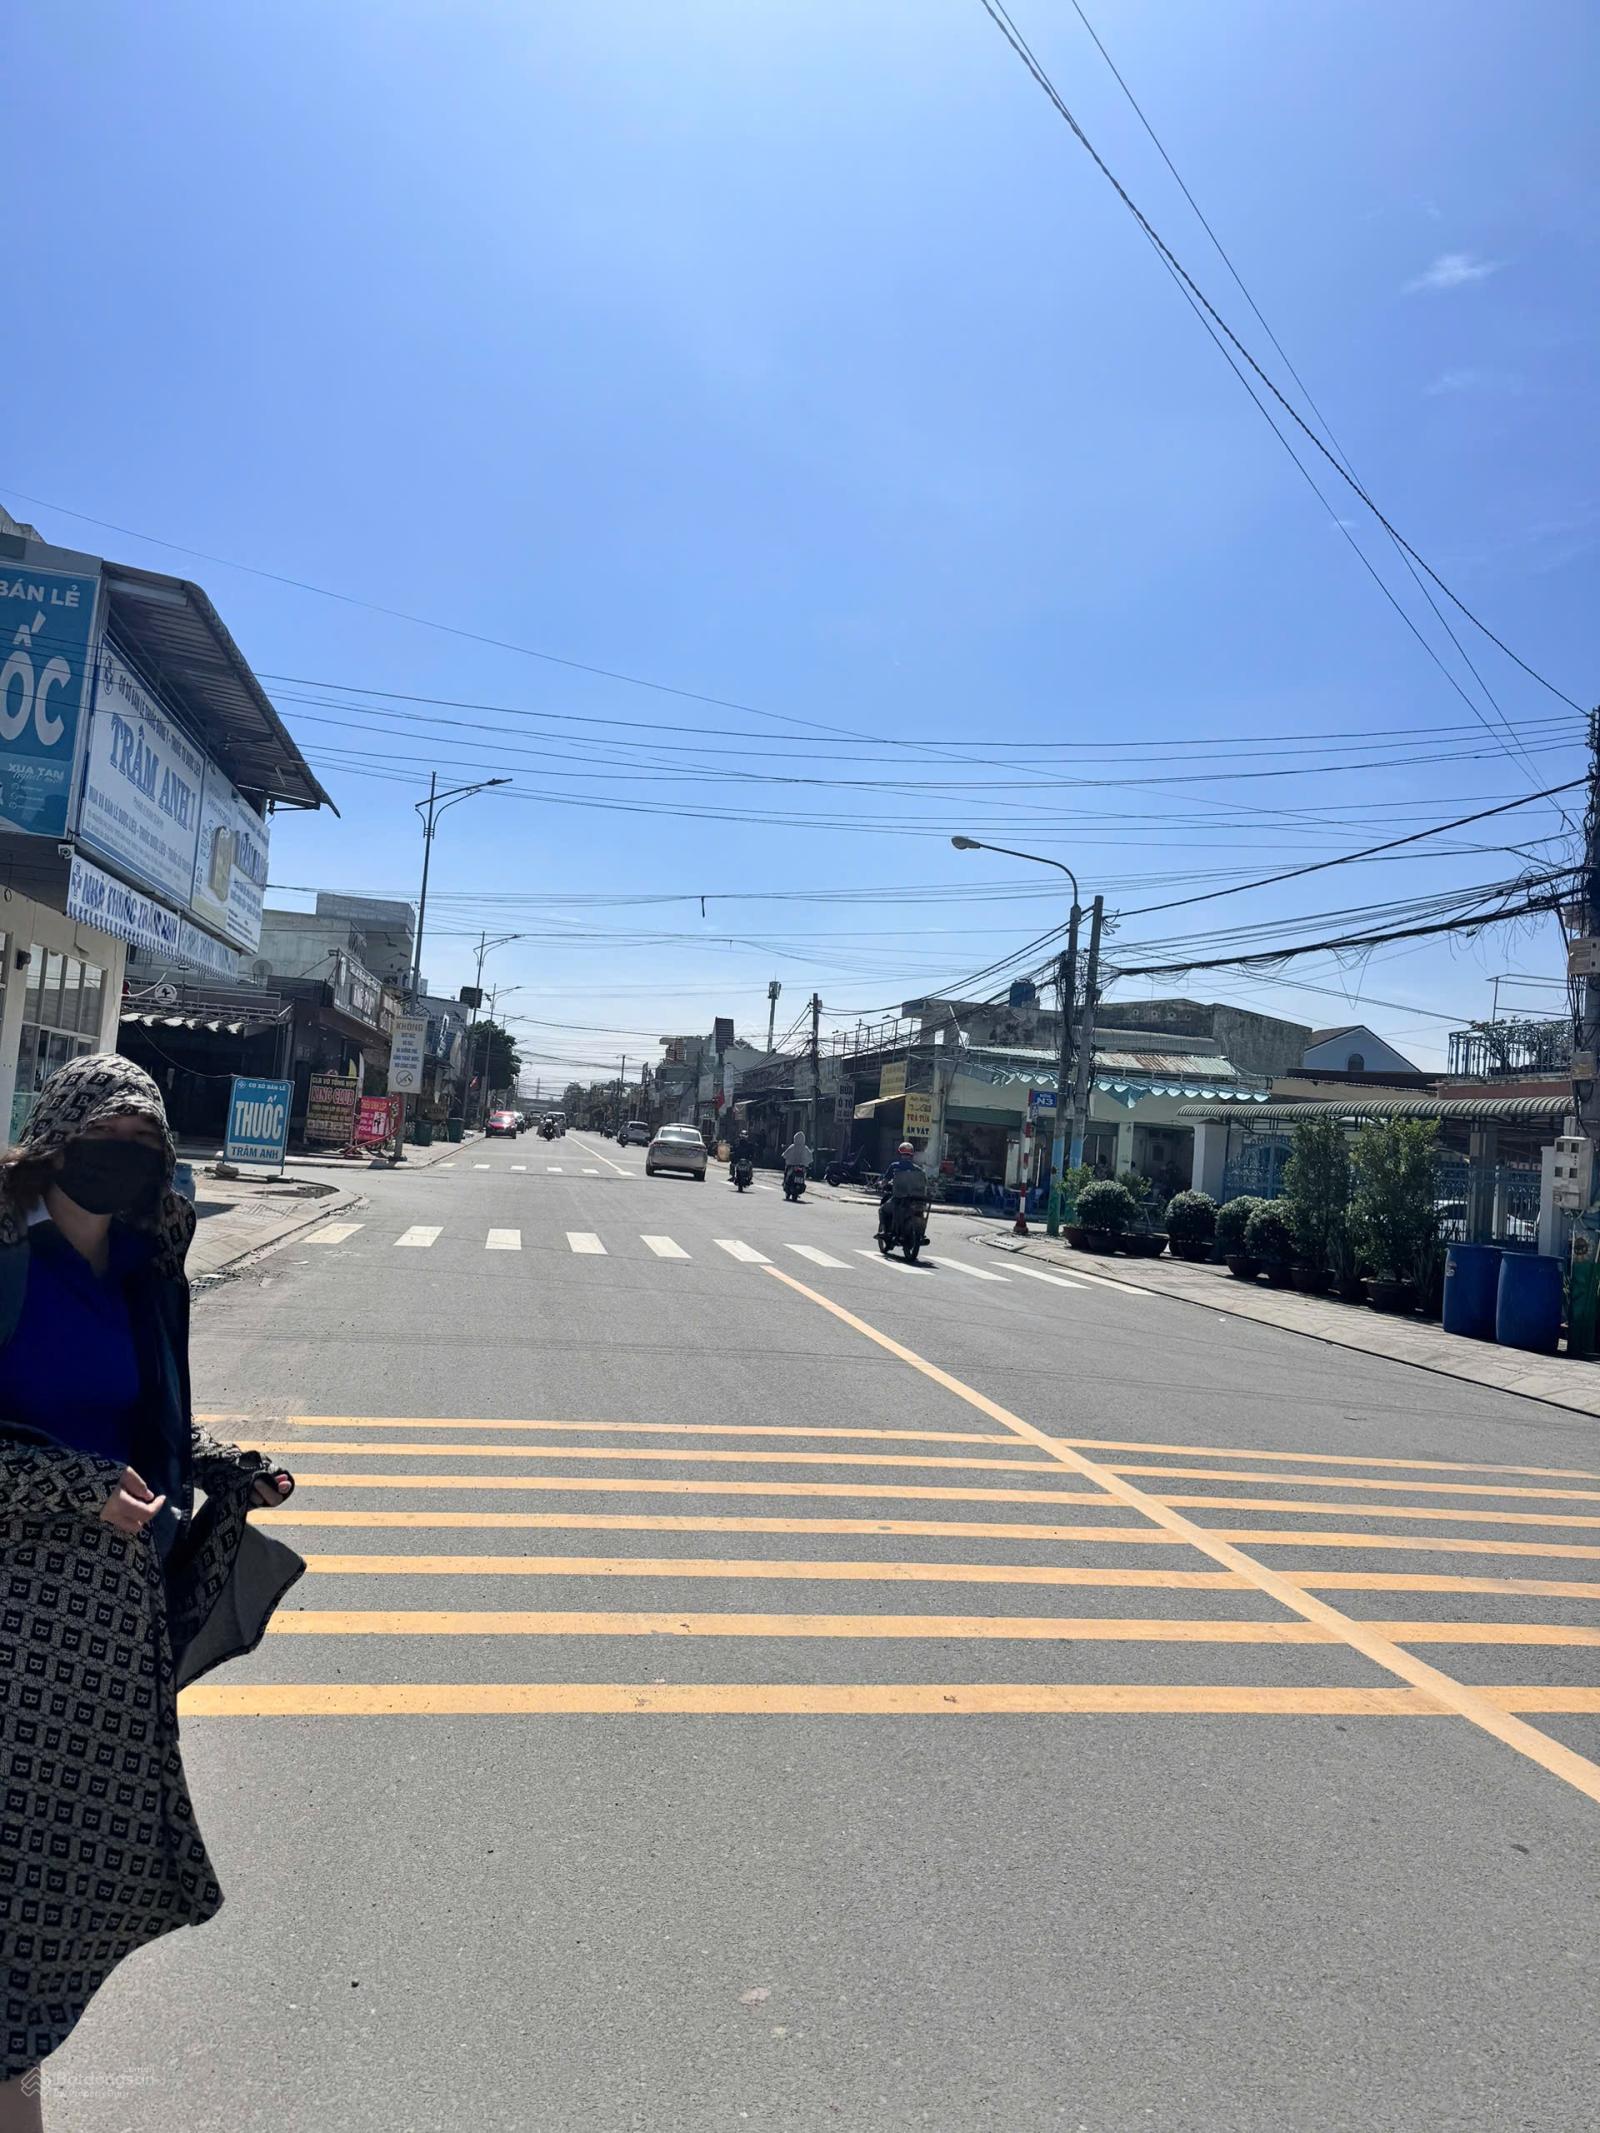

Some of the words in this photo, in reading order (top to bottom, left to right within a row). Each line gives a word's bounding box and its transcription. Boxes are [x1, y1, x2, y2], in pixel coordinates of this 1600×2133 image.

[50, 585, 81, 608] LẺ
[38, 767, 64, 780] TAN
[110, 713, 159, 803] TRÂM
[158, 766, 190, 830] ANH
[234, 1095, 284, 1140] THUỐC
[259, 1148, 279, 1160] ANH
